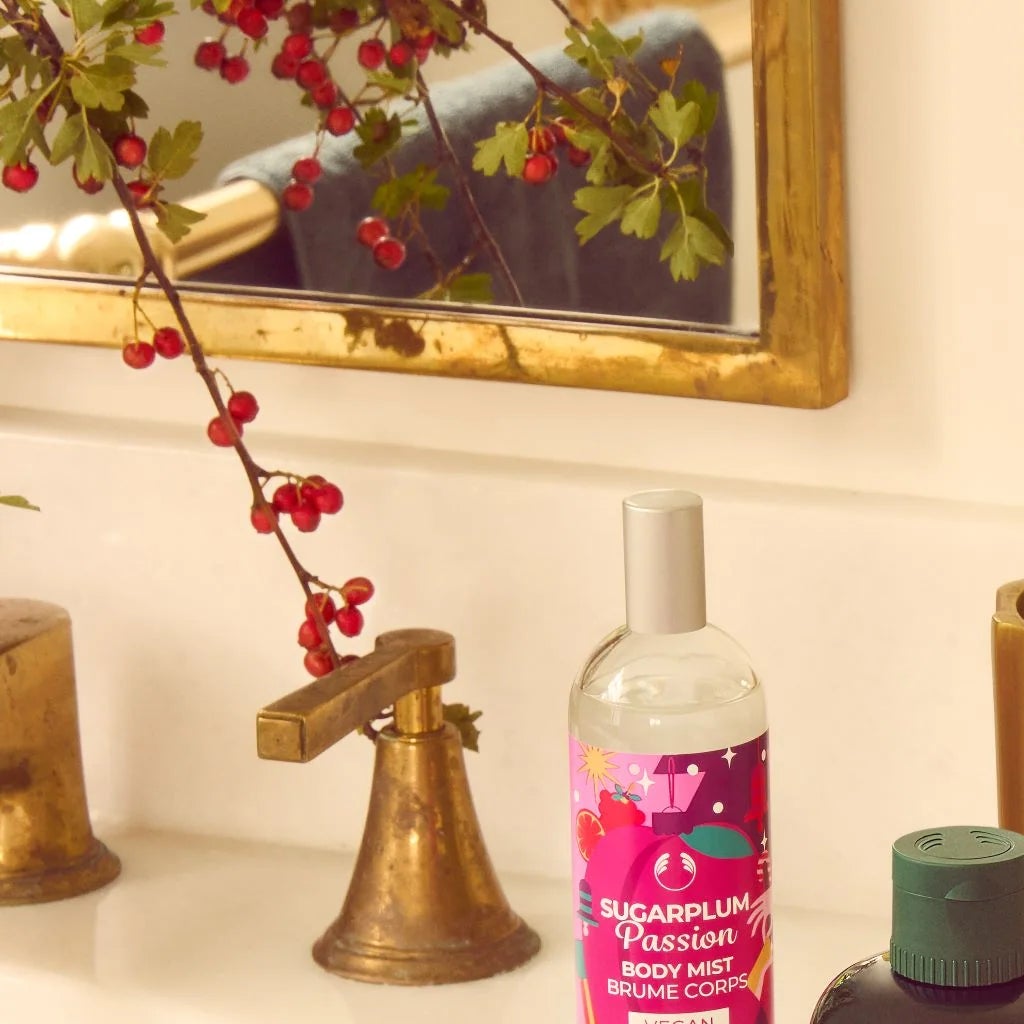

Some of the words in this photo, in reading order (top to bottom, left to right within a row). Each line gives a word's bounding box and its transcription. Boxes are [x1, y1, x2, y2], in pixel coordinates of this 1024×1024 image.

[600, 892, 749, 924] SUGARPLUM
[615, 920, 737, 952] Passion
[622, 961, 681, 978] BODY
[688, 956, 734, 977] MIST
[608, 979, 678, 999] BRUME
[685, 973, 748, 996] CORPS
